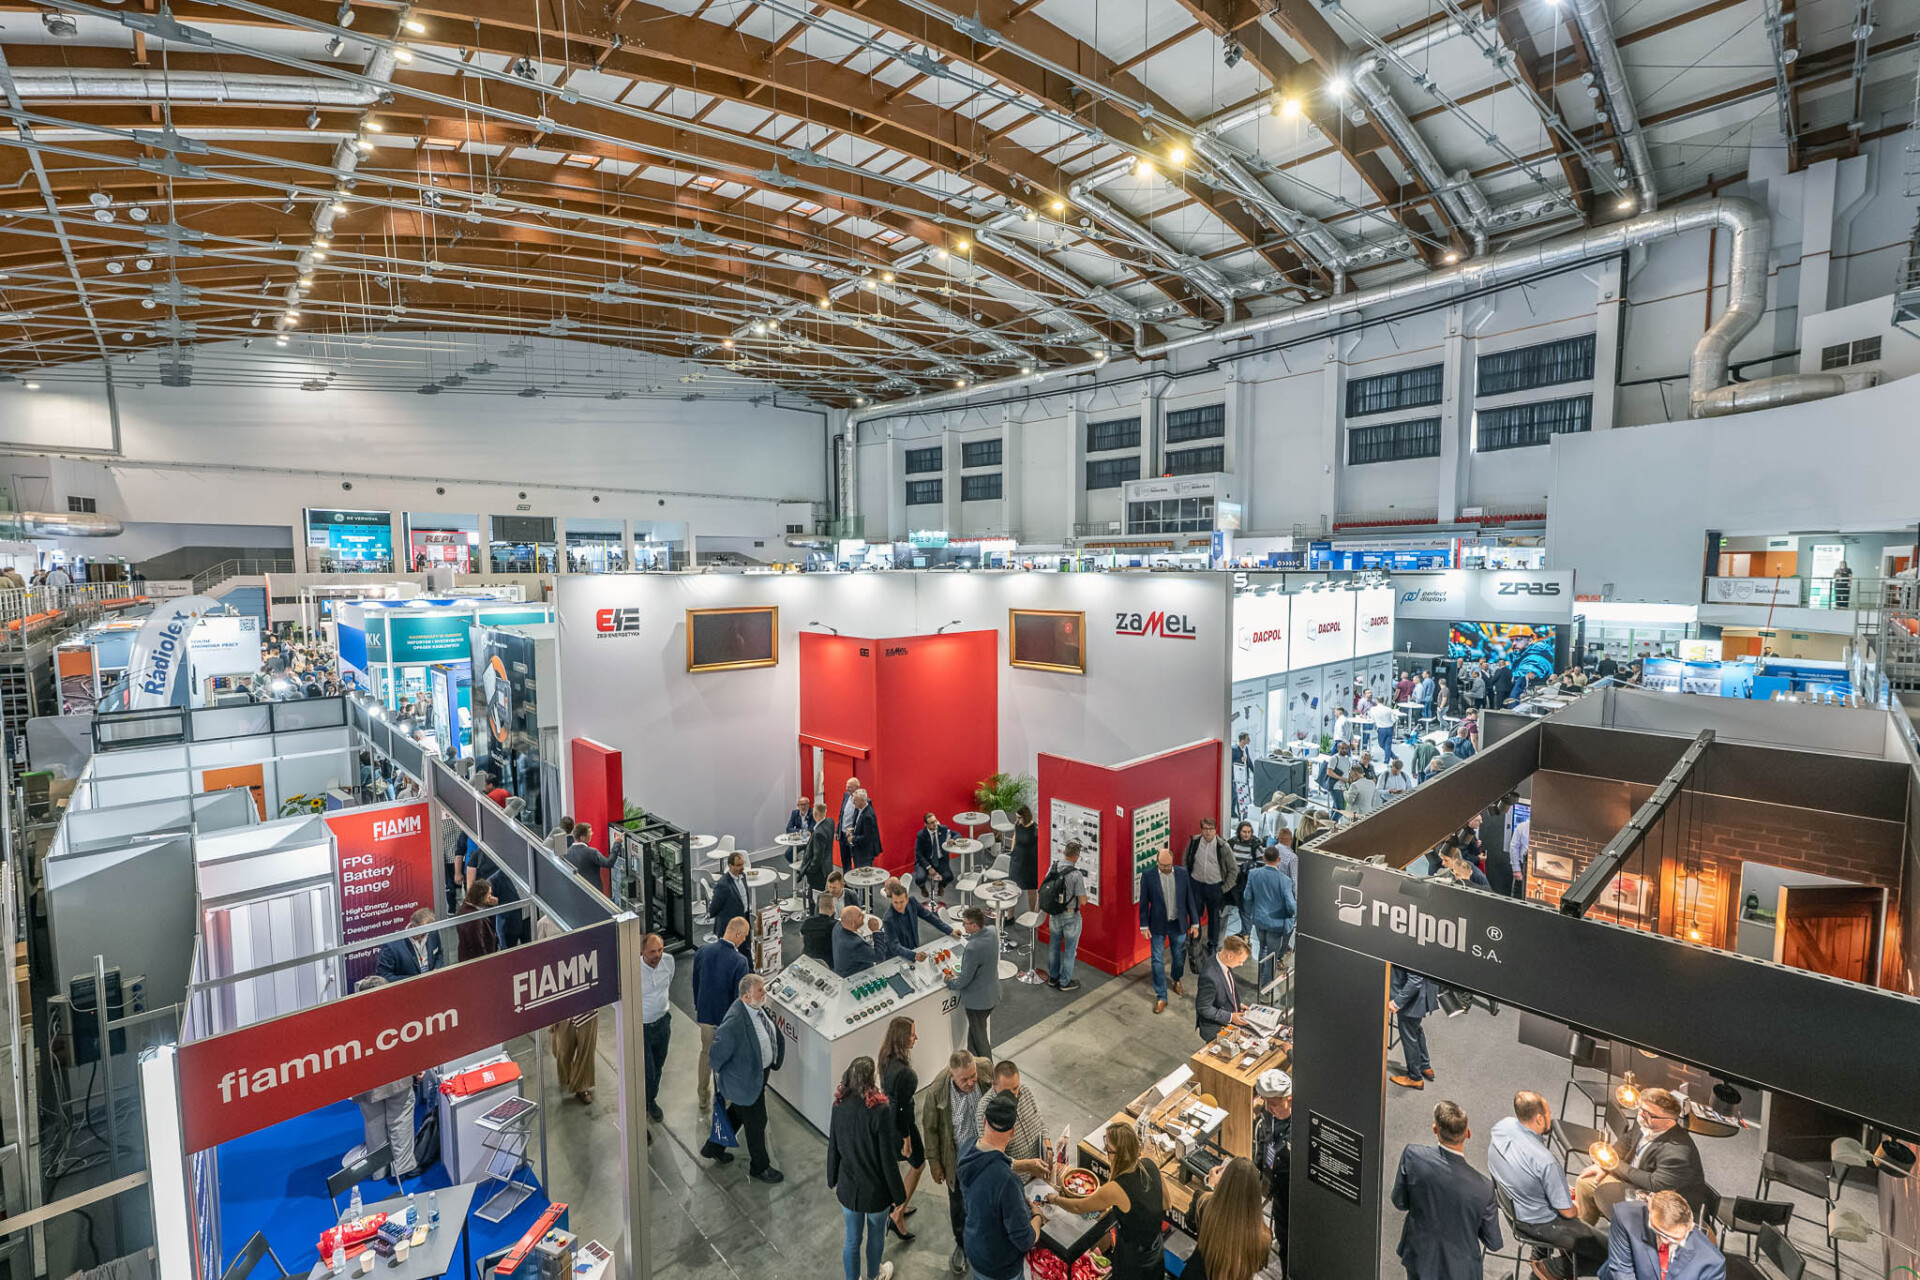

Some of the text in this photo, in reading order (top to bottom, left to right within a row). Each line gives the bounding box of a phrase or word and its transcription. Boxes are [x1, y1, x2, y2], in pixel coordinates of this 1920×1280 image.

[1252, 629, 1282, 643] DACPOL
[1318, 621, 1341, 634] DACPOL
[144, 610, 190, 695] Radiolex
[373, 815, 421, 839] FIAMM
[342, 854, 373, 869] FPG
[343, 865, 395, 883] Battery
[344, 880, 390, 897] Range
[346, 902, 390, 916] High Energy
[360, 907, 394, 919] Compact
[394, 901, 419, 911] Design
[347, 921, 381, 935] Designed
[382, 919, 393, 927] for
[1371, 899, 1468, 953] relpol
[348, 950, 372, 960] Safety
[1471, 944, 1503, 964] S.A.
[216, 950, 599, 1104] fiamm.com FIAMM
